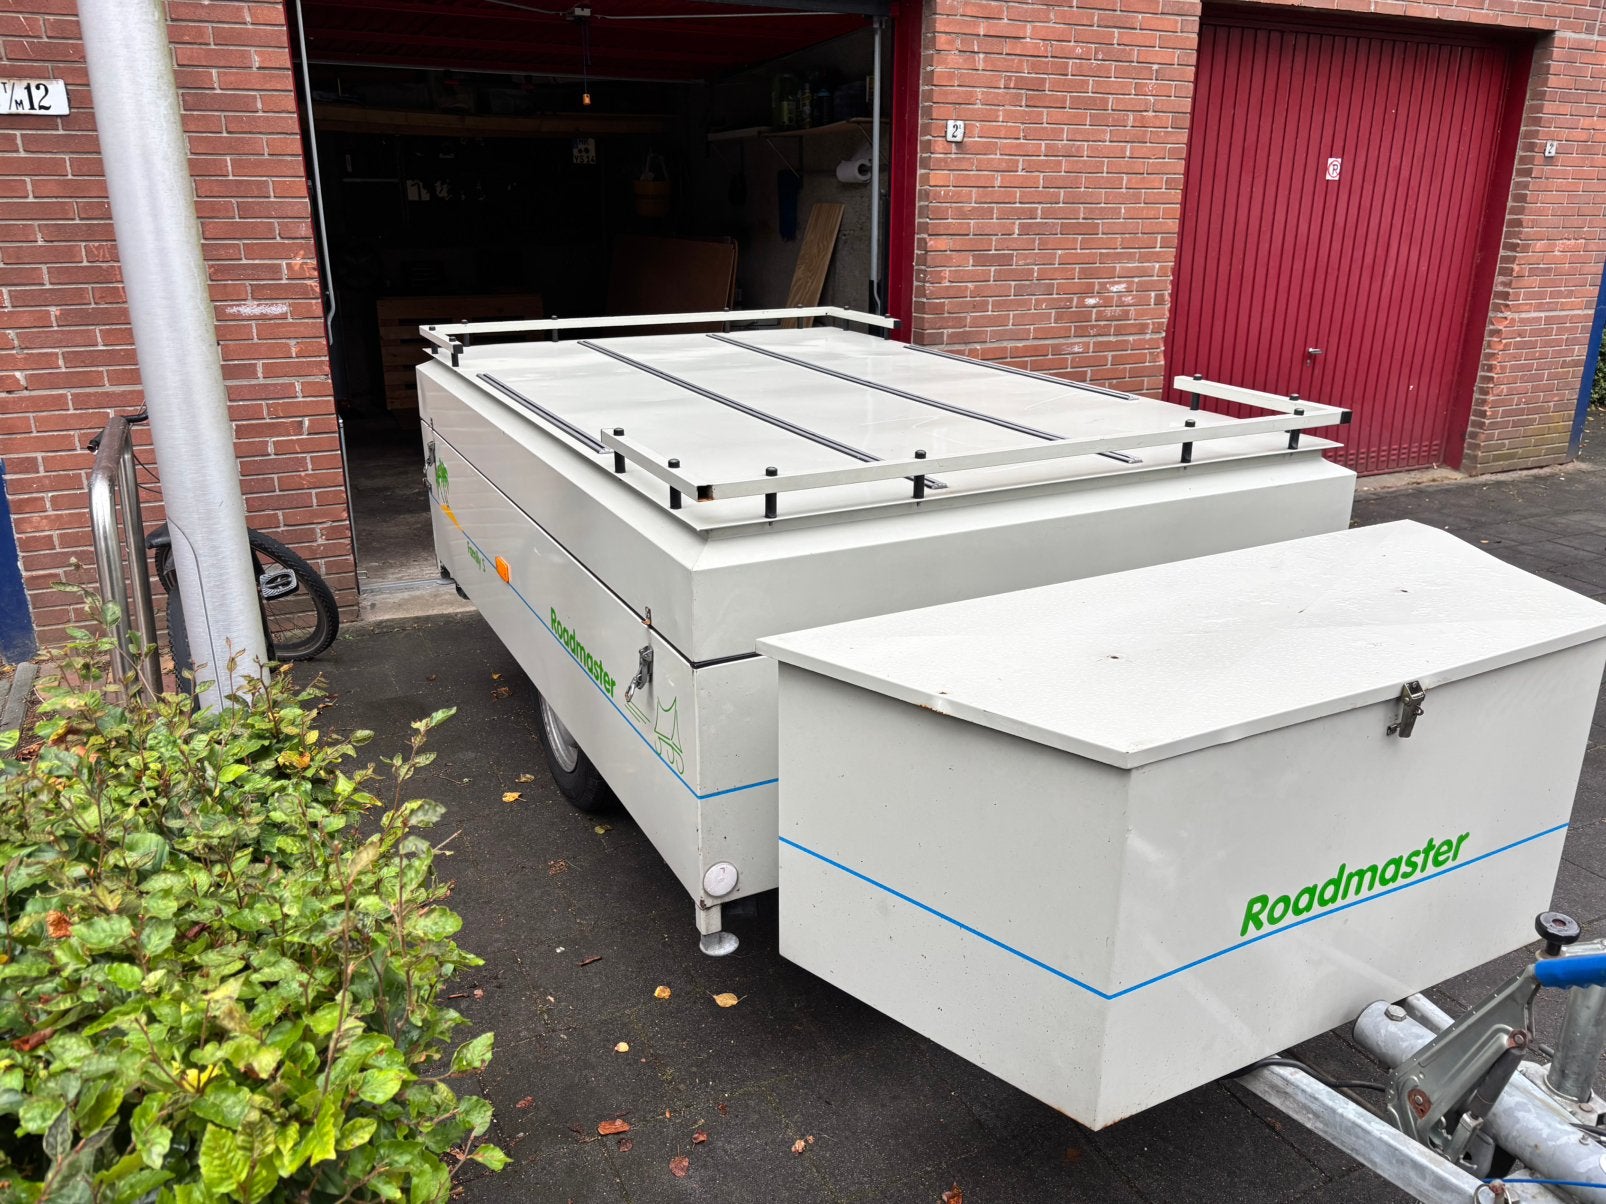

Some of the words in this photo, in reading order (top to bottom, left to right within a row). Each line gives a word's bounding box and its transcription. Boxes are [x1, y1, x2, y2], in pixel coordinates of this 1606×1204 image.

[24, 82, 51, 110] 12
[551, 607, 616, 698] Roadmaster
[1240, 832, 1470, 936] Roadmaster
